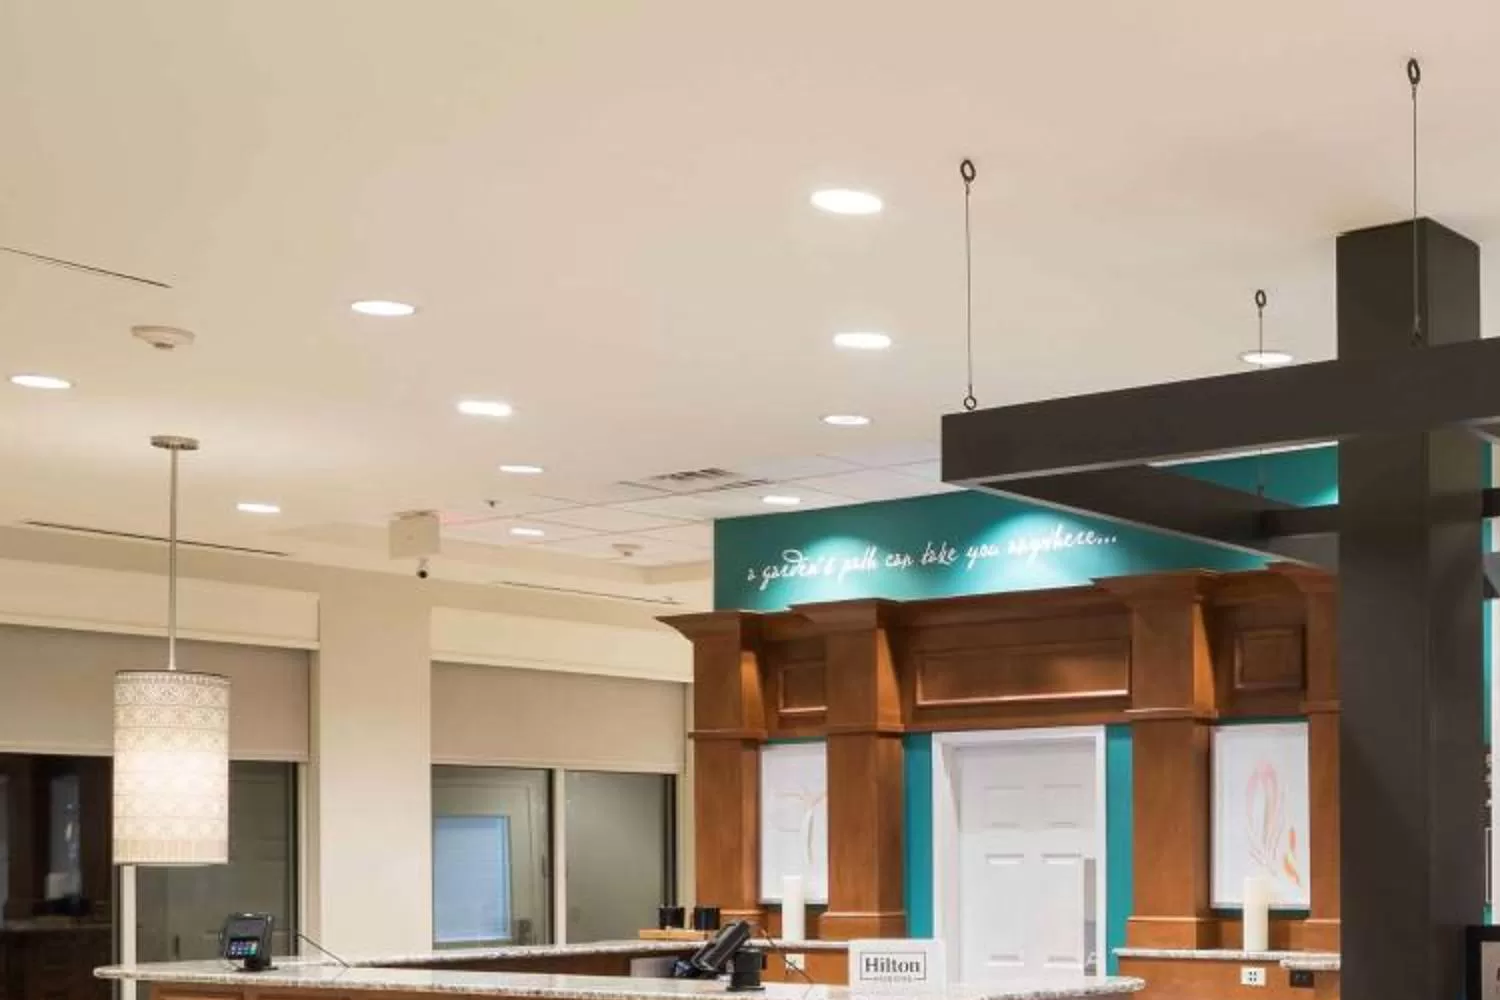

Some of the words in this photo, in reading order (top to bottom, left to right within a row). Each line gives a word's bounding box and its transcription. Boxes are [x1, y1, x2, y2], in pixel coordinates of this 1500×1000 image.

[838, 546, 877, 584] path
[885, 552, 914, 569] can
[921, 541, 957, 566] take
[966, 543, 999, 570] you
[865, 957, 921, 973] Hilton
